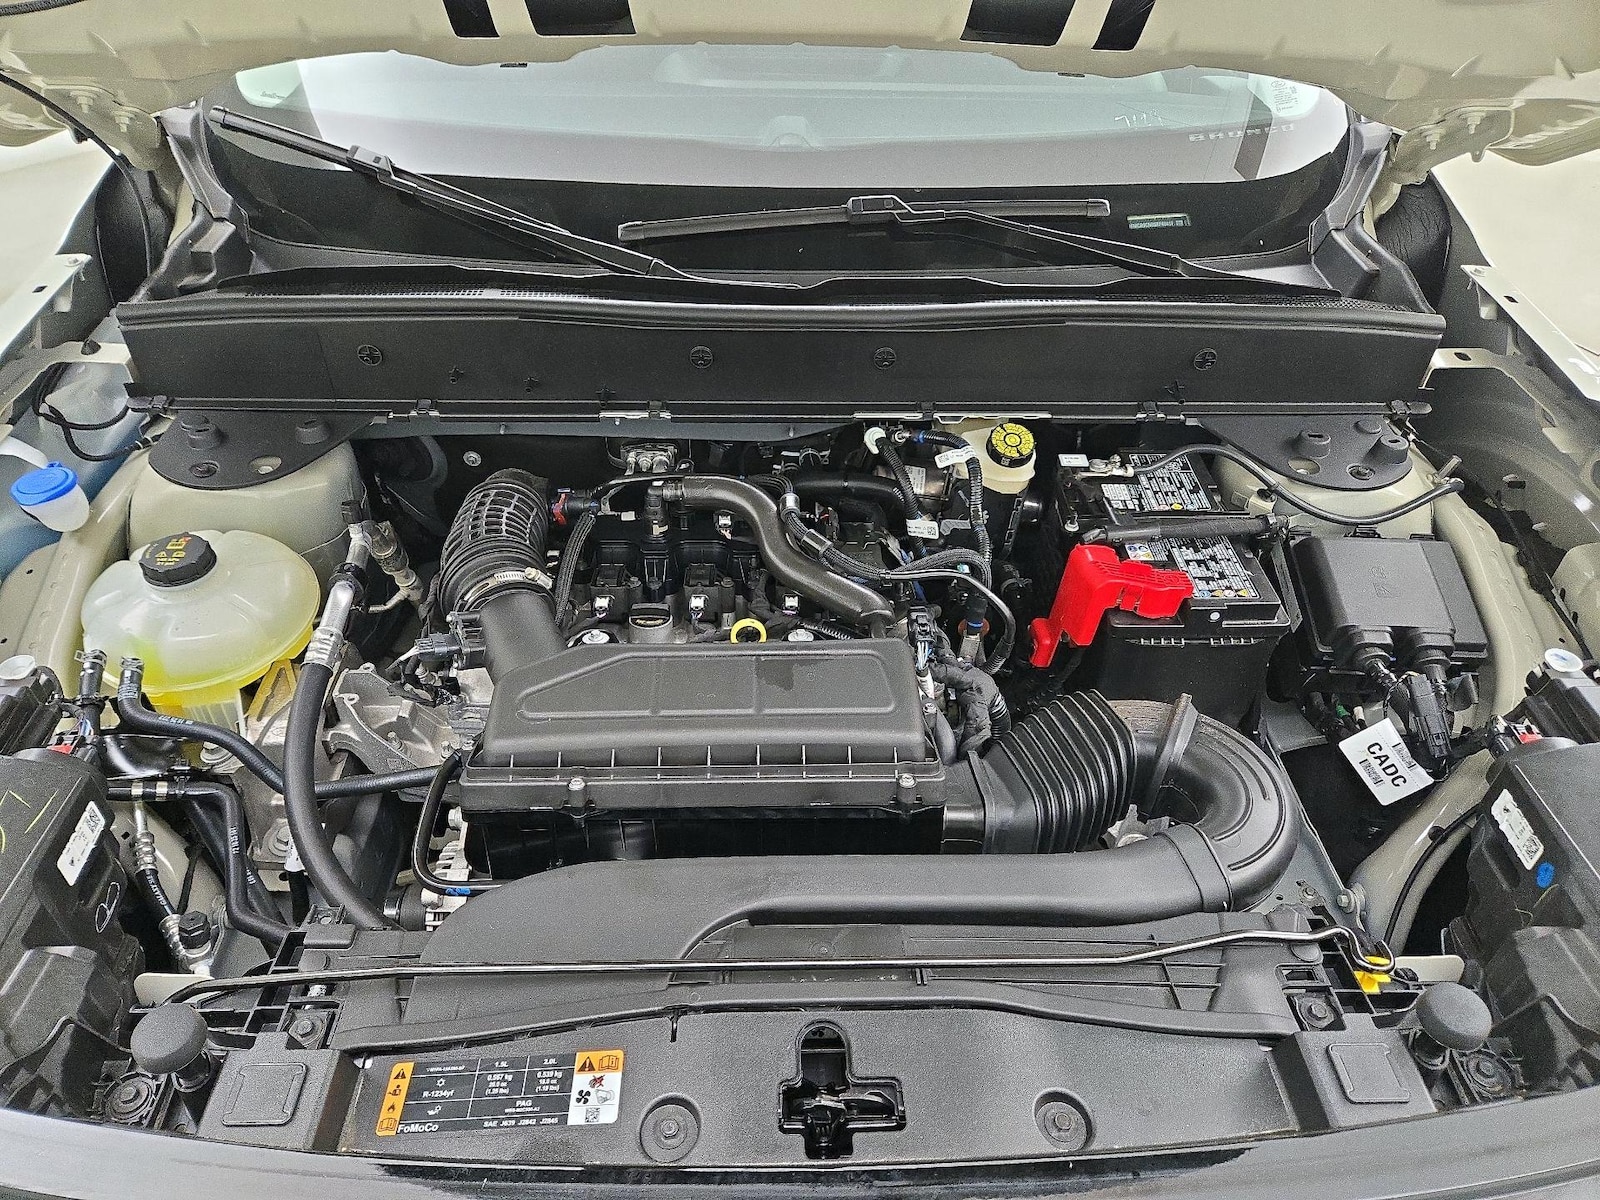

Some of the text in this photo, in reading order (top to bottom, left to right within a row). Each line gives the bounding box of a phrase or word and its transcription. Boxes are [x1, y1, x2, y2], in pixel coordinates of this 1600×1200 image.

[1367, 742, 1407, 787] CADC
[422, 1089, 455, 1099] R-1234yf
[397, 1123, 439, 1133] FoMoCo
